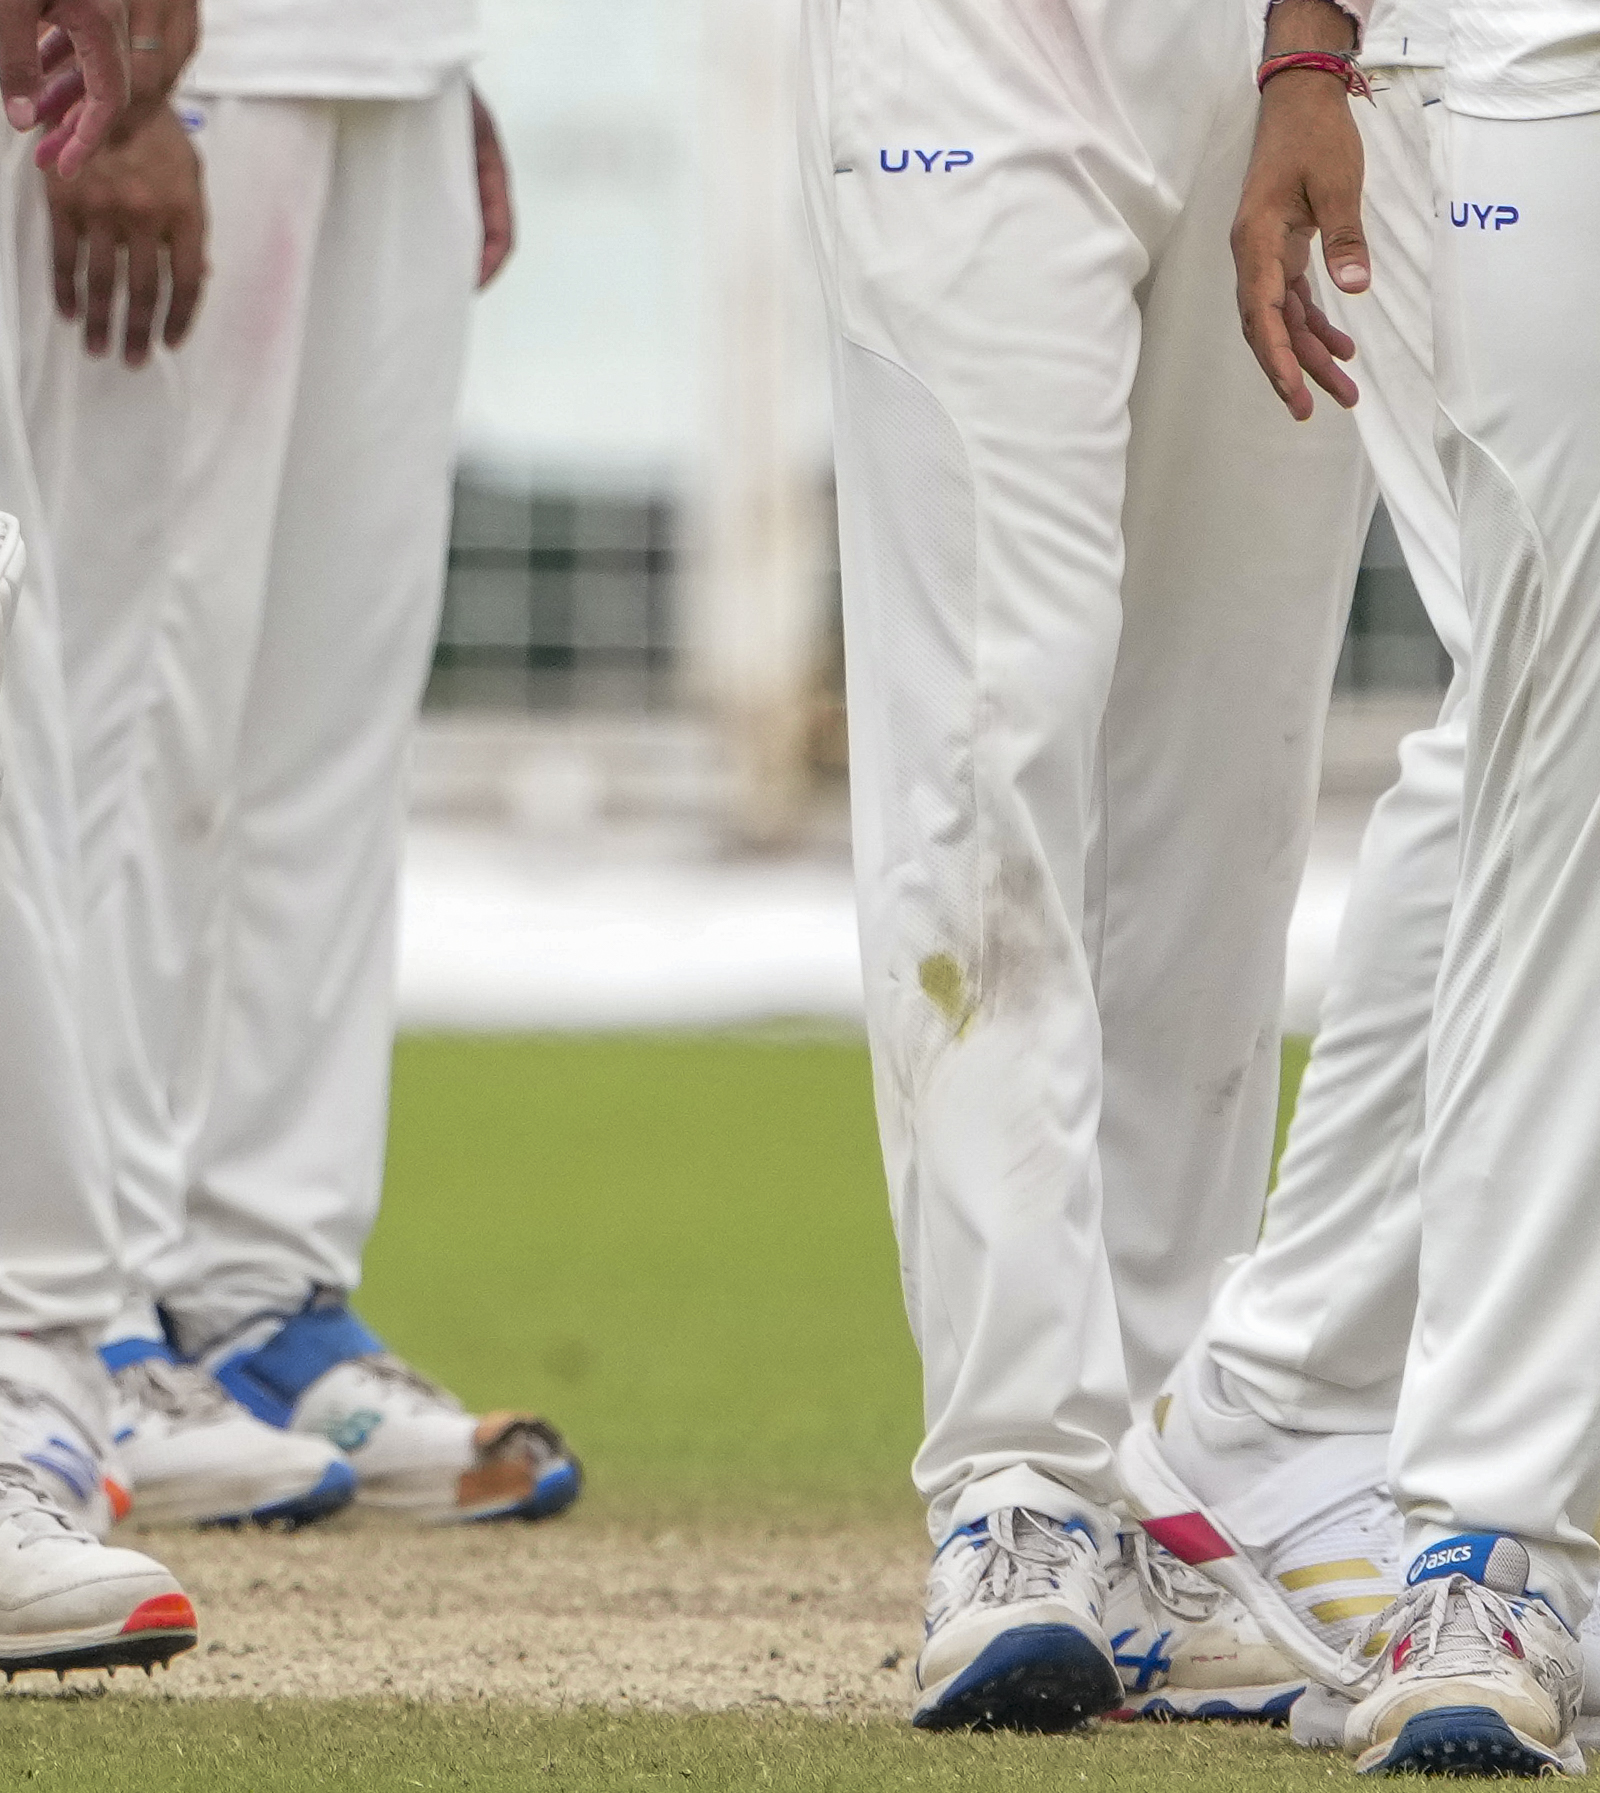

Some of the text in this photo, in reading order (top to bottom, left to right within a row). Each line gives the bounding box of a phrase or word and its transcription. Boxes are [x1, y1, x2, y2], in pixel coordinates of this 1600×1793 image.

[880, 149, 974, 173] UYP
[1450, 200, 1520, 231] UYP
[1425, 1544, 1473, 1571] asics
